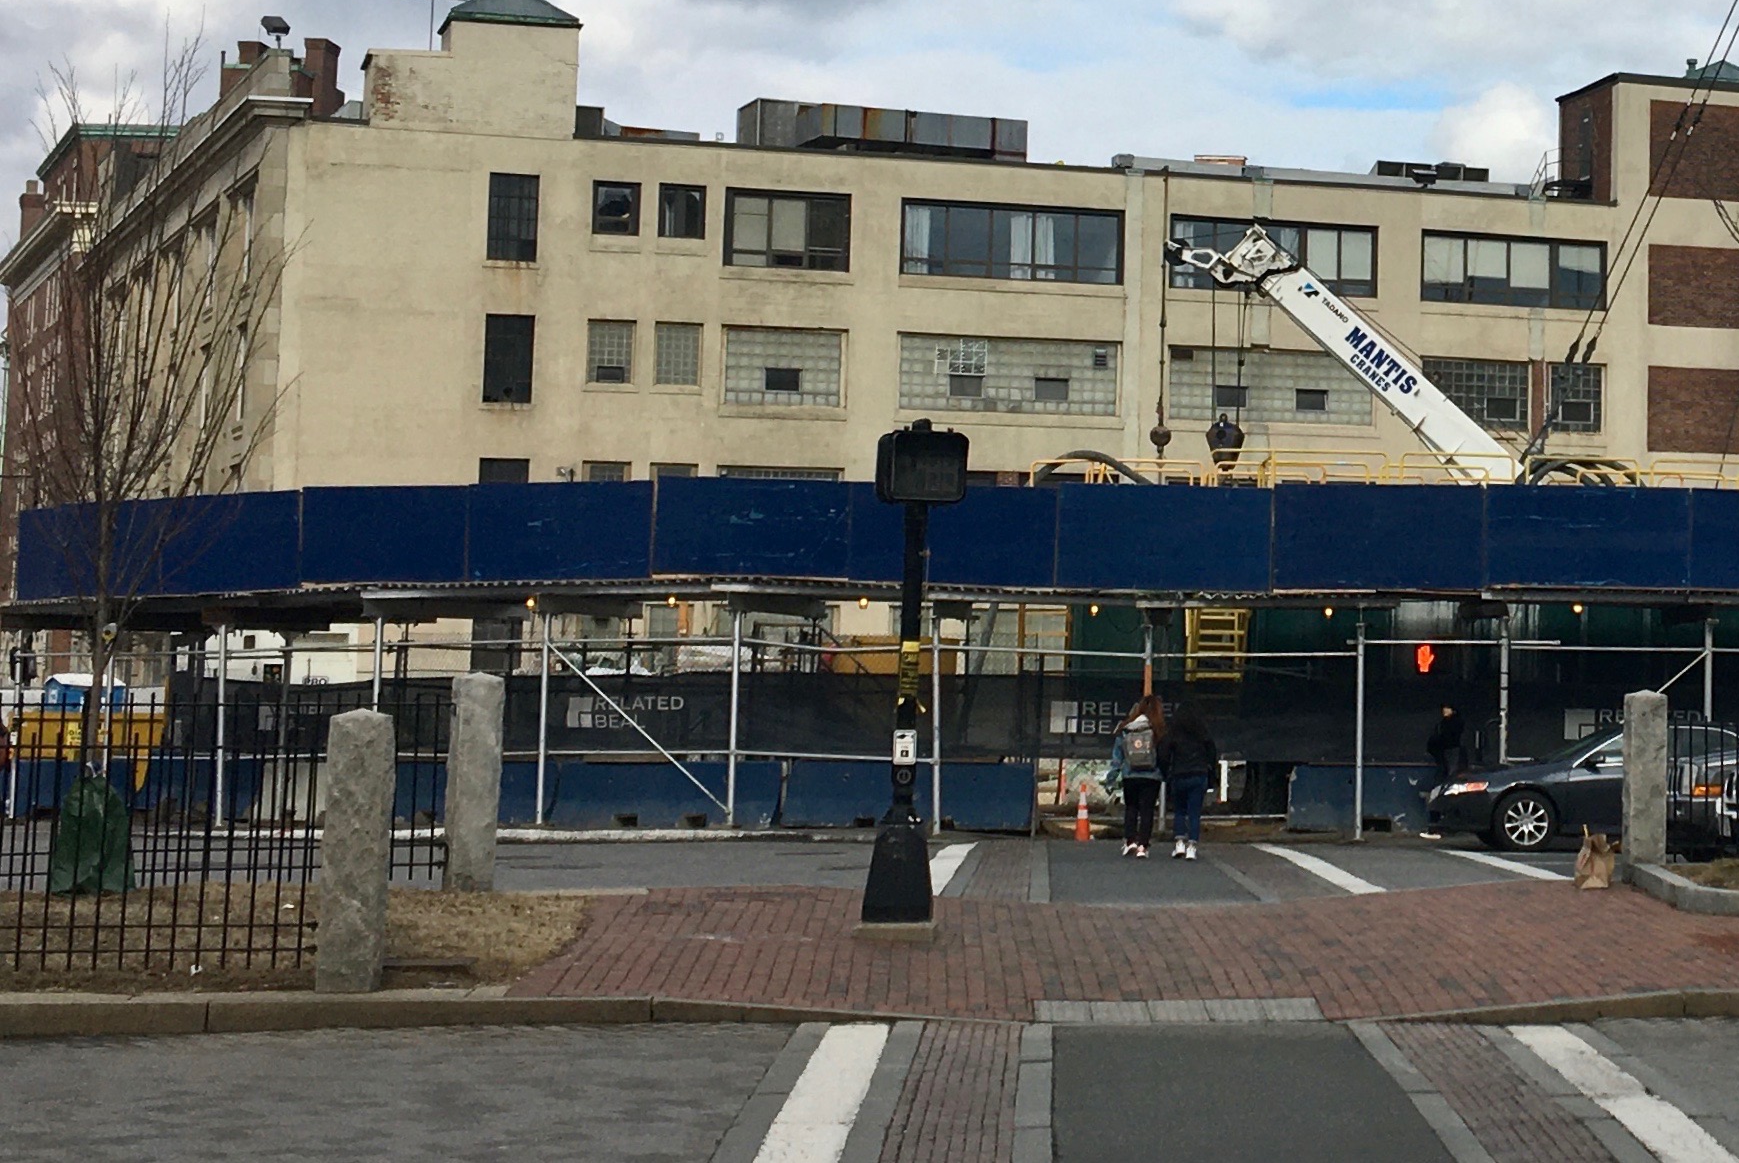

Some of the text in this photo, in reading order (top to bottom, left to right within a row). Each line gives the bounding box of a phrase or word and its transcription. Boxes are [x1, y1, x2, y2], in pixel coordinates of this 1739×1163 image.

[1321, 297, 1350, 324] TADANO
[1344, 326, 1418, 394] MANTIS
[1349, 353, 1392, 392] CRANES
[594, 696, 685, 711] RELATED
[594, 714, 646, 729] BEAL
